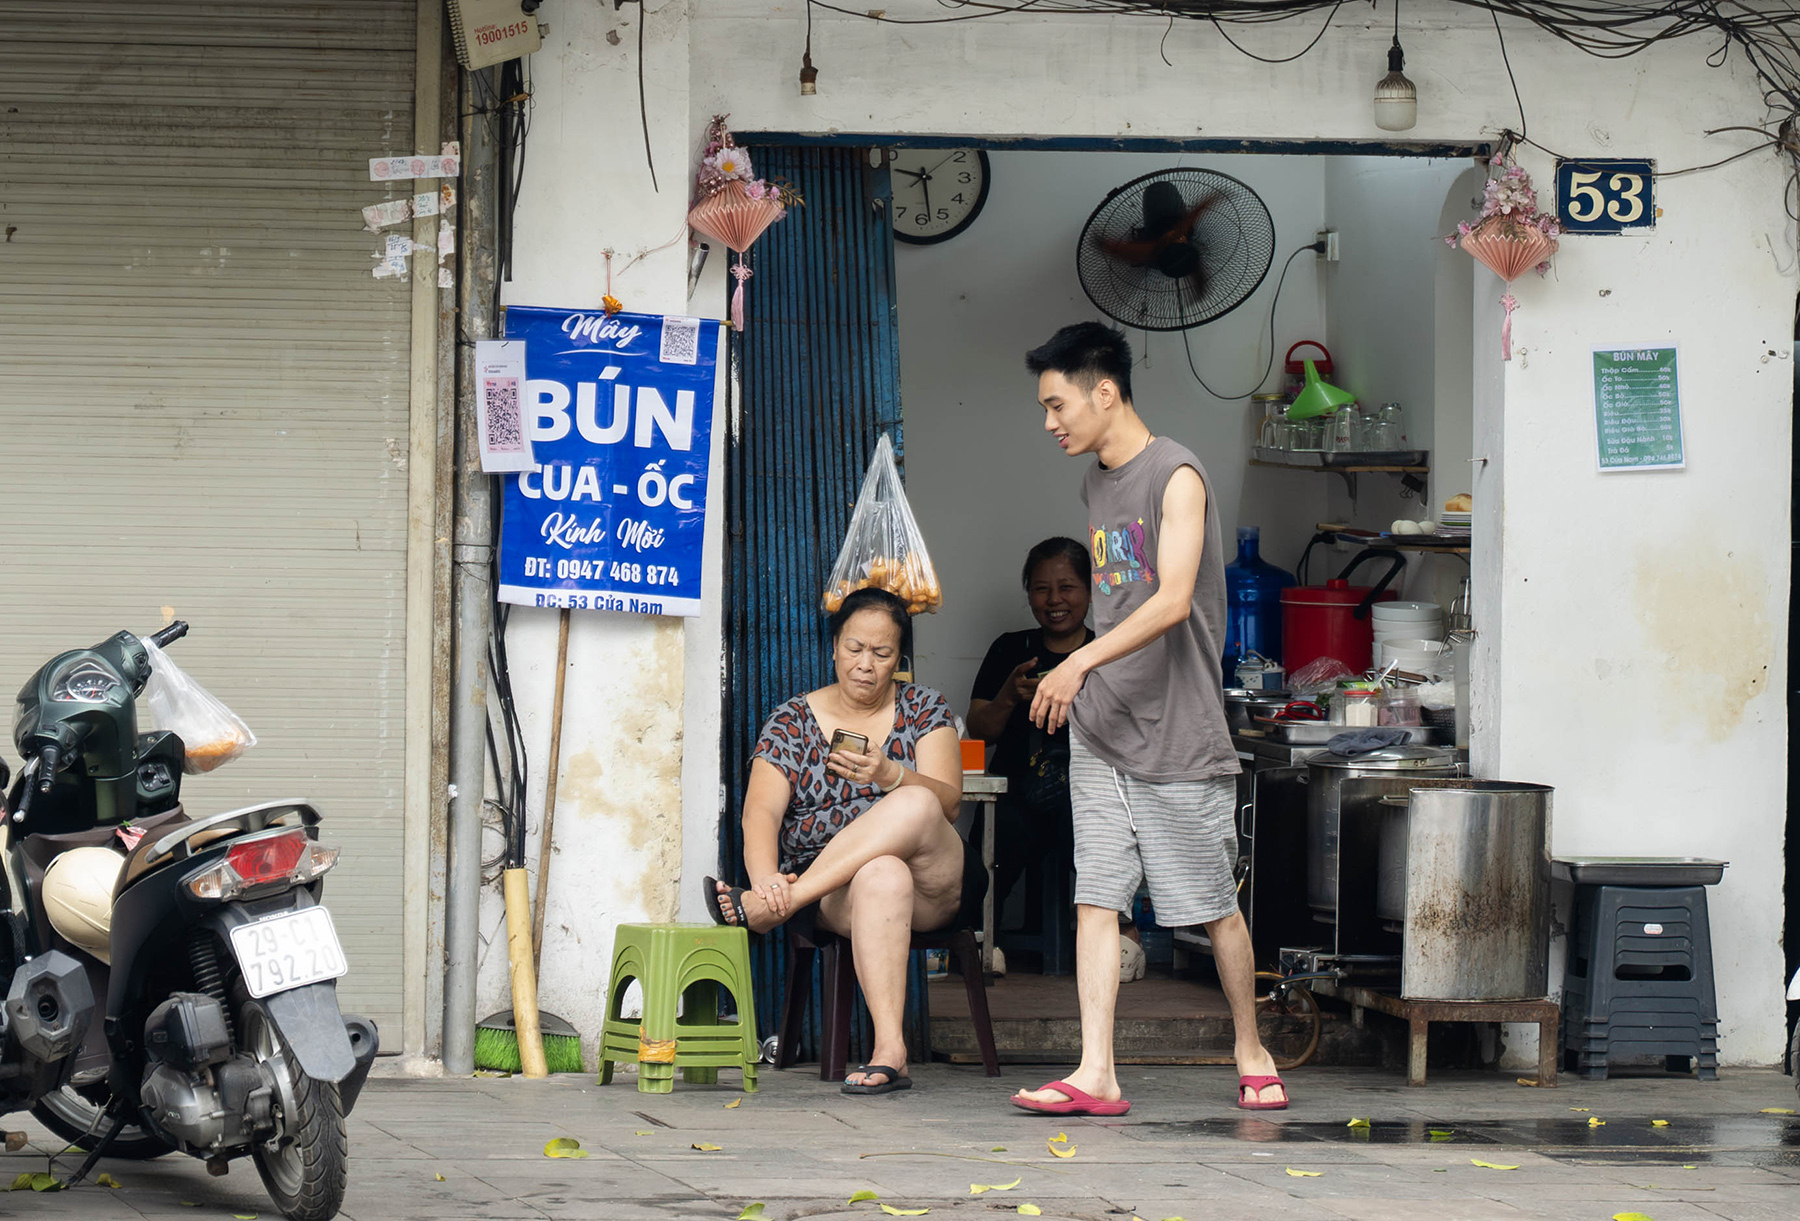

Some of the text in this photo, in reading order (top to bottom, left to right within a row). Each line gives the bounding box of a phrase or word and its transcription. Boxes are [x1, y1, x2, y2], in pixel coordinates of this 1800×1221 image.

[475, 20, 528, 46] 19001515
[953, 151, 966, 163] 2
[958, 172, 971, 183] 3
[951, 193, 964, 204] 4
[1568, 171, 1643, 222] 53
[895, 207, 907, 218] 7
[915, 213, 928, 225] 6
[936, 208, 949, 220] 5
[561, 313, 643, 348] Mây
[1613, 350, 1634, 361] BÚN
[525, 366, 695, 451] BÚN
[518, 459, 694, 509] CUA - ỐC
[540, 511, 665, 553] Kính Mời
[524, 556, 679, 586] ĐT: 0947 468 874
[536, 593, 663, 615] ĐC: 53 Cửa Nam
[248, 916, 319, 957] 29-C1
[250, 945, 338, 991] 792.20
